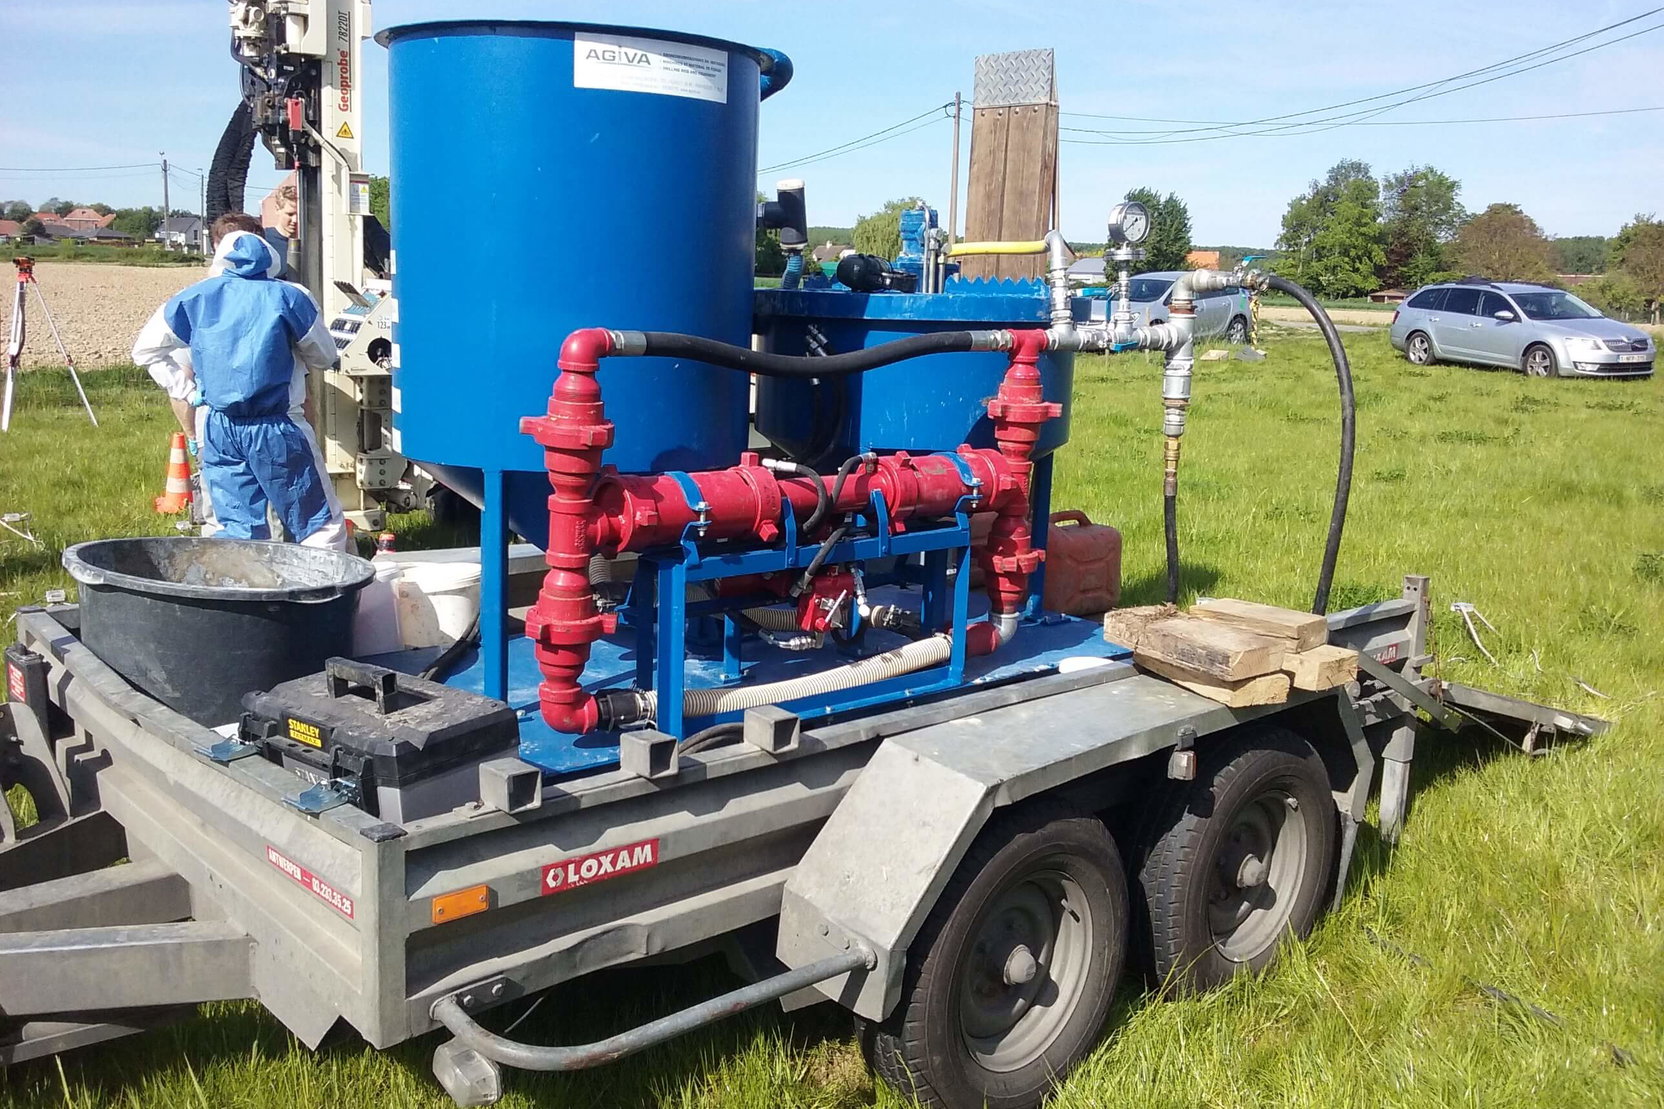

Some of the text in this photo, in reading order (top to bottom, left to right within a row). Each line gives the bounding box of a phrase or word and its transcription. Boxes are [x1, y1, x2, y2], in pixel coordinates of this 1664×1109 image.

[337, 10, 351, 112] Geoprobe 7822DT
[287, 718, 320, 738] STANLEY
[567, 844, 653, 884] LOXAM
